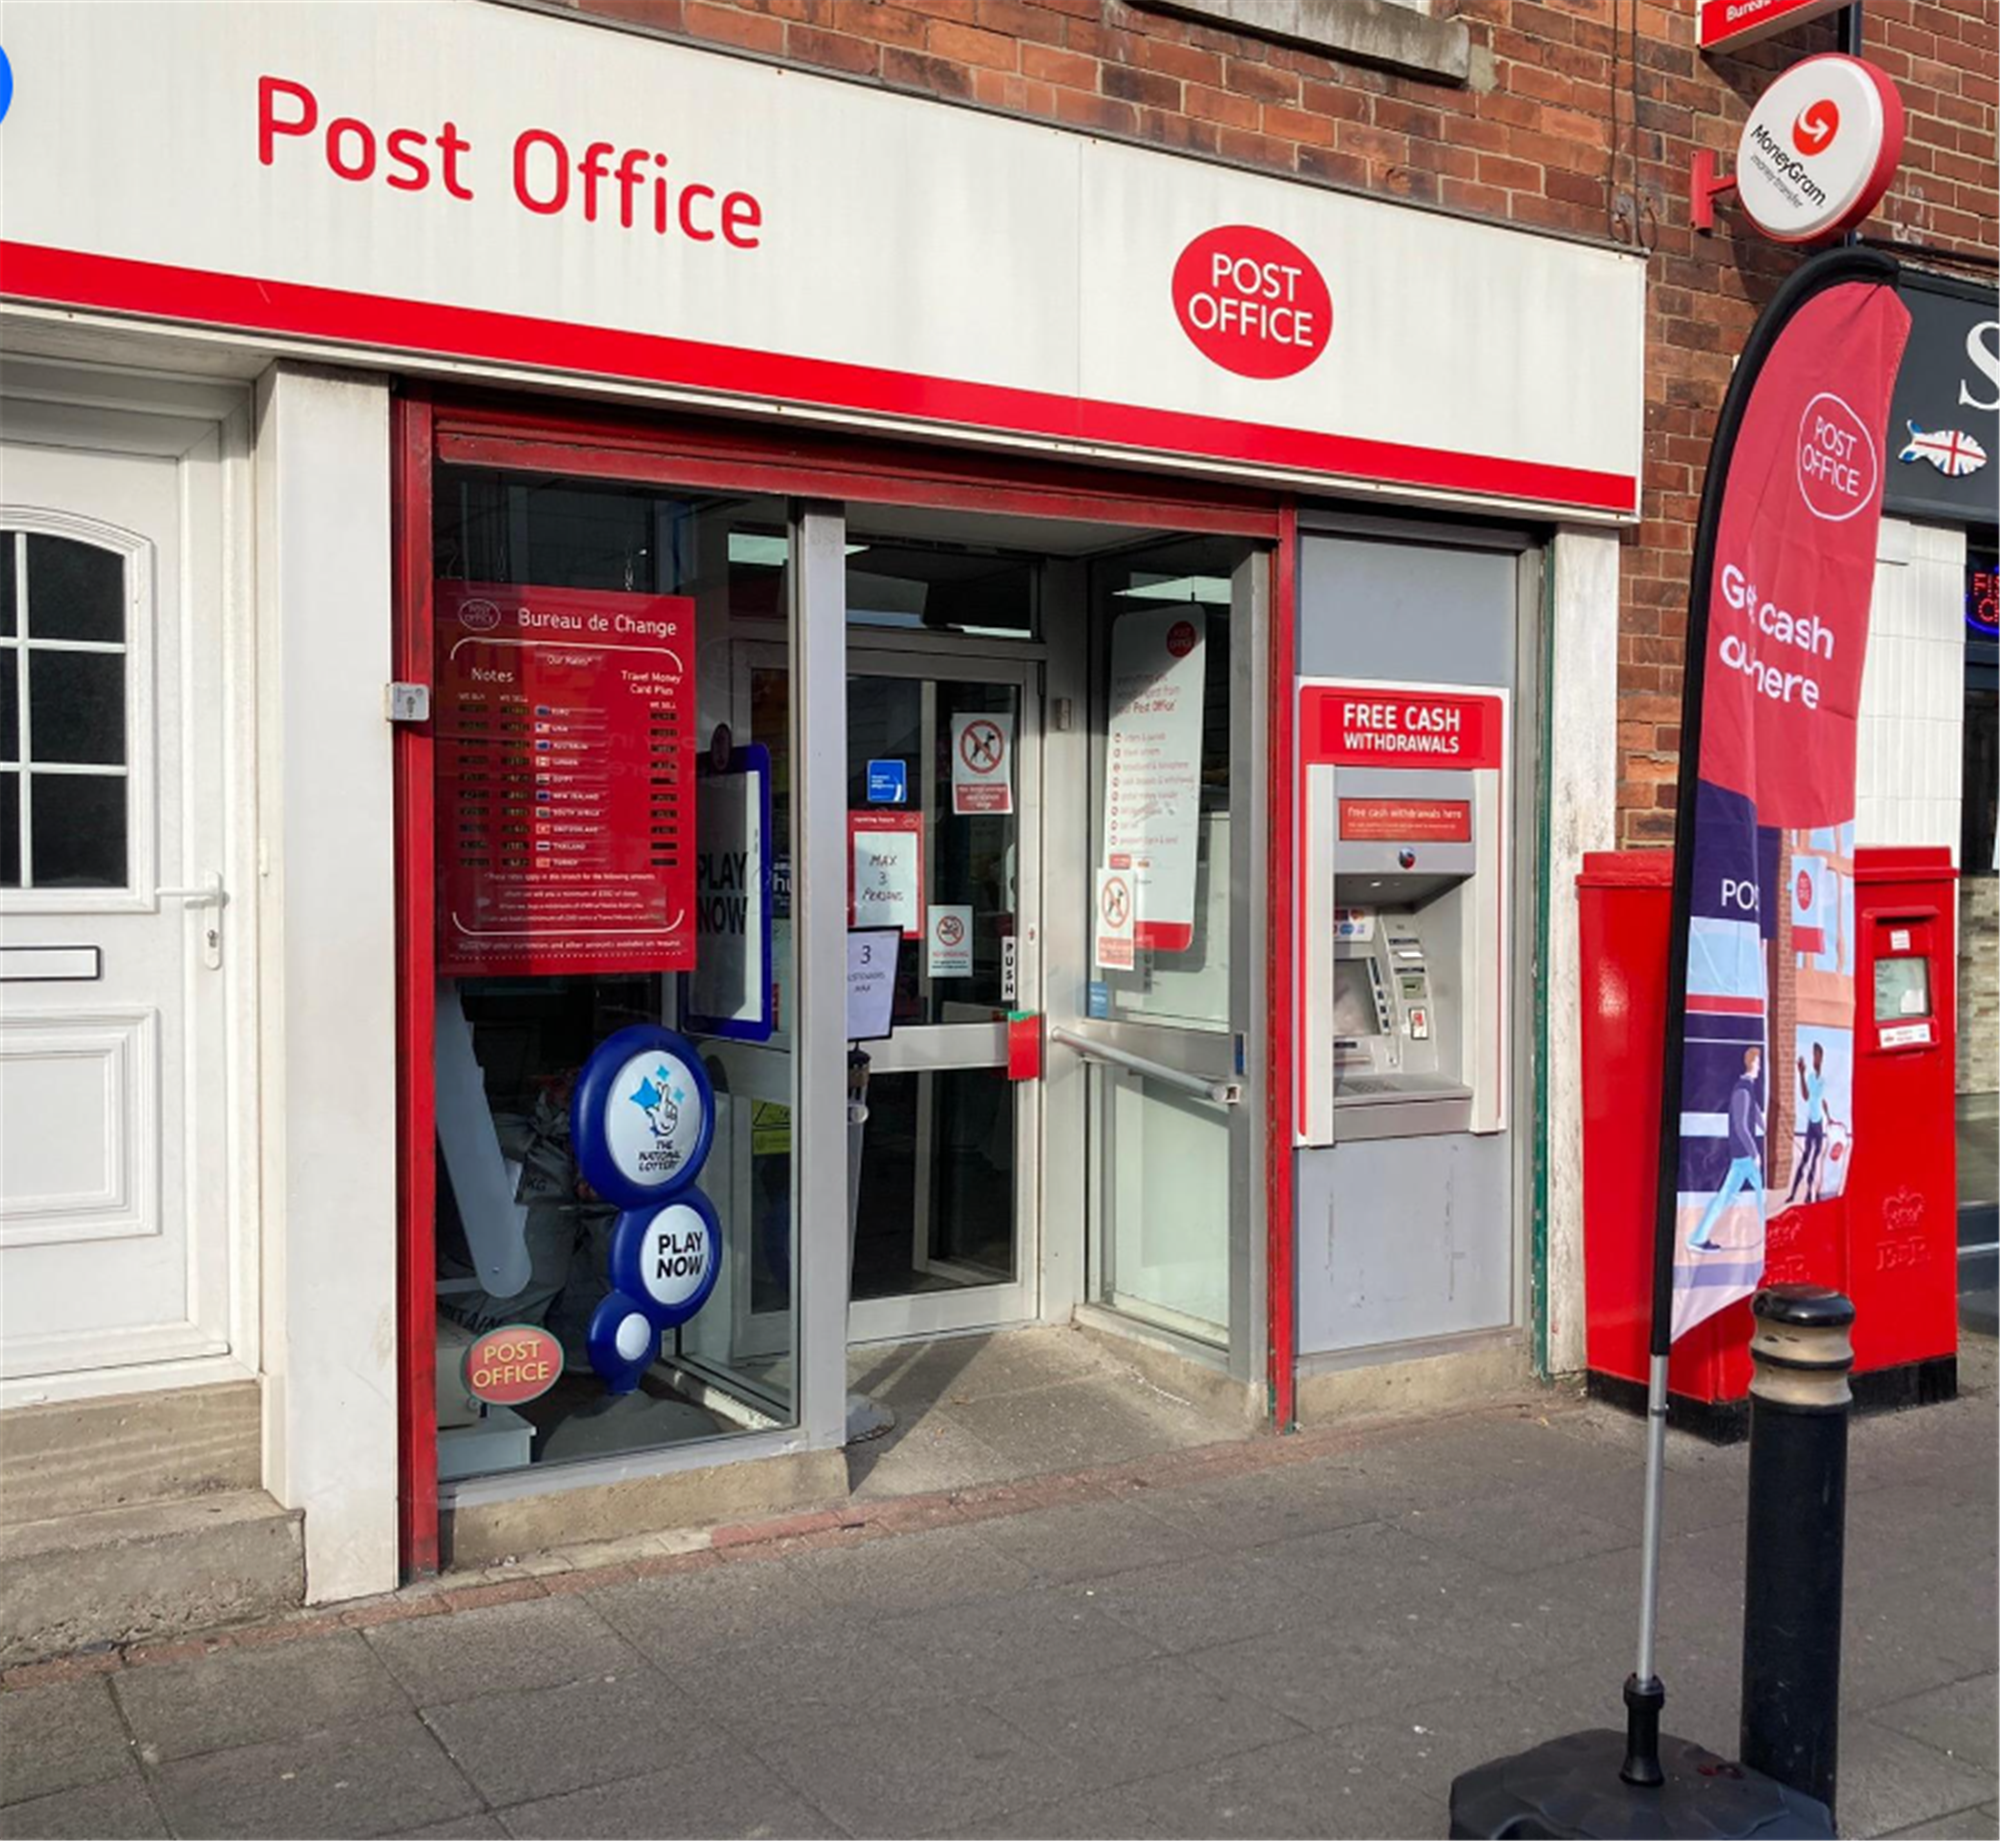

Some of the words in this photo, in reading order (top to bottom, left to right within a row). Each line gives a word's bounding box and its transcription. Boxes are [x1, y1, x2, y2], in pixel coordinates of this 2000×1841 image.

[258, 75, 474, 201] Post
[513, 129, 762, 249] Office
[1751, 124, 1826, 207] MoneyGram
[1212, 252, 1303, 302] POST
[1188, 292, 1314, 348] OFFICE
[1815, 415, 1858, 461] POST
[1801, 443, 1860, 498] OFFICE
[517, 607, 582, 630] Bureau
[588, 614, 609, 632] de
[614, 614, 677, 638] Change
[1759, 602, 1835, 660] cash
[471, 667, 515, 683] Notes
[621, 669, 649, 681] Travel
[651, 671, 682, 684] Money
[630, 682, 651, 695] Card
[654, 684, 674, 696] Plus
[1343, 703, 1398, 730] FREE
[1404, 706, 1460, 733] CASH
[1343, 732, 1460, 754] WITHDRAWALS
[1368, 808, 1389, 819] cash
[1390, 808, 1441, 819] withdrawals
[1442, 809, 1462, 820] here
[697, 852, 748, 890] PLAY
[869, 853, 898, 867] MAX
[878, 870, 889, 887] 3
[697, 896, 748, 936] NOW
[860, 944, 871, 965] 3
[1005, 942, 1015, 994] PUSH
[639, 1150, 682, 1161] NATIONAL
[656, 1139, 674, 1150] THE
[638, 1160, 679, 1172] LOTTERY
[658, 1231, 704, 1255] PLAY
[656, 1254, 704, 1279] NOW
[483, 1339, 542, 1366] POST
[472, 1361, 550, 1390] OFFICE
